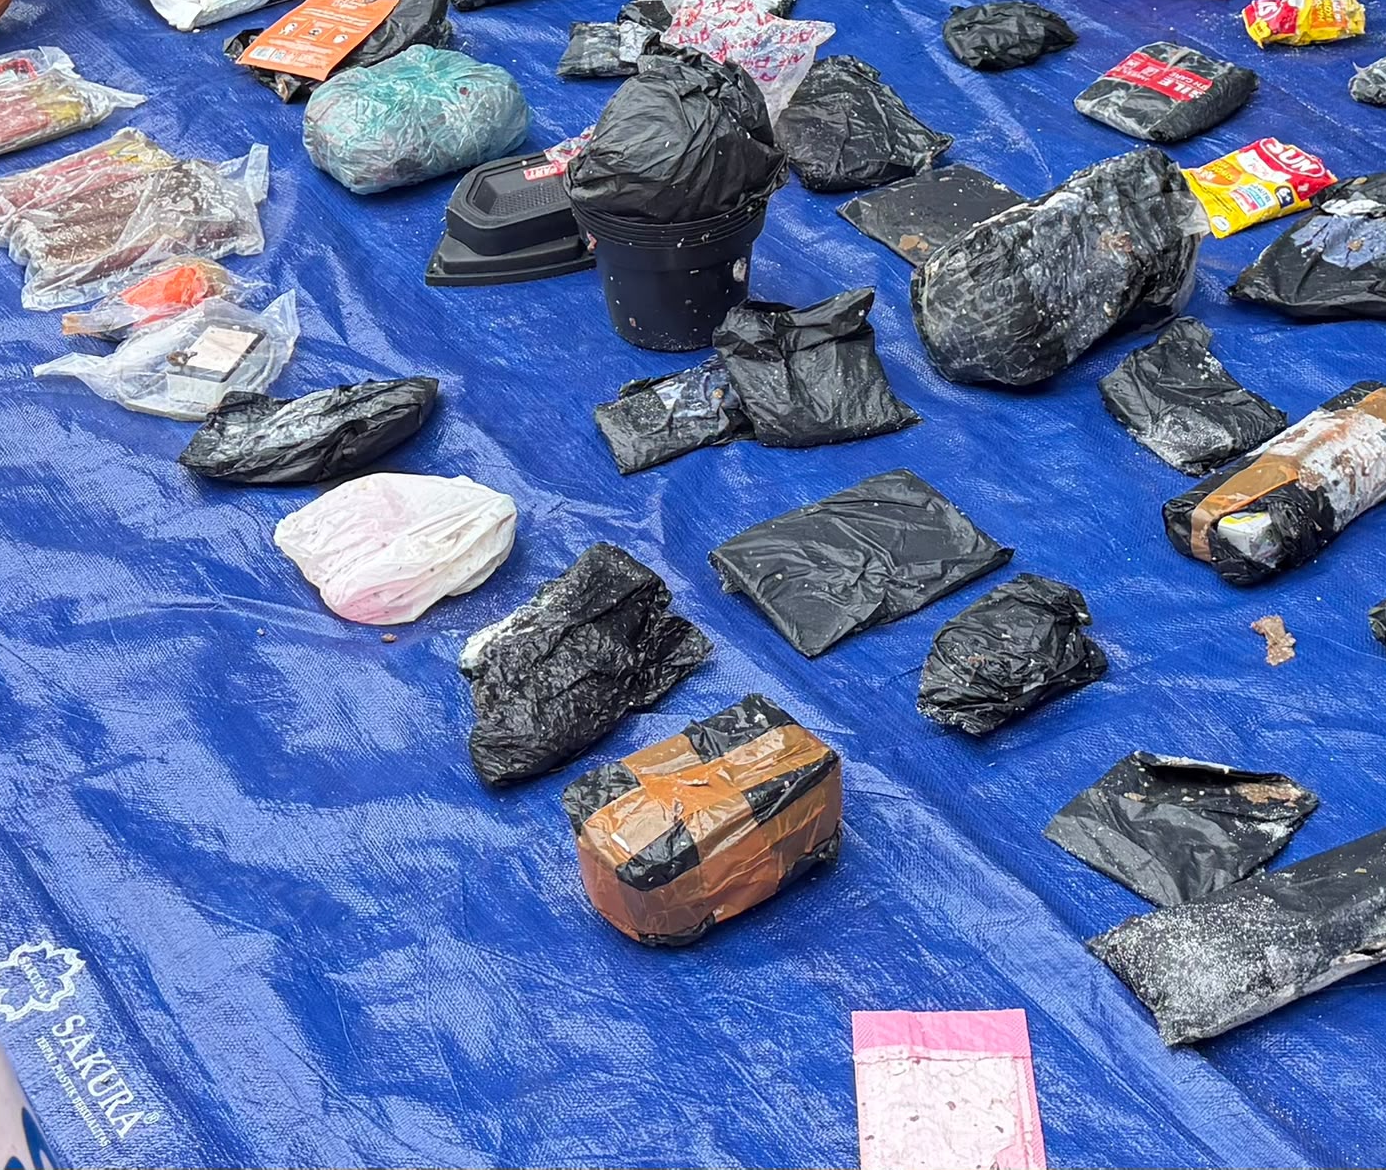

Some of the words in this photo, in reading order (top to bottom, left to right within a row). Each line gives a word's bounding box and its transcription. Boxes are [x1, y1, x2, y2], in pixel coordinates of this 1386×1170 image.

[1265, 141, 1320, 173] SUN
[18, 955, 50, 999] SAKURA
[51, 1014, 146, 1139] SAKURA
[52, 1060, 76, 1098] PLASTIK
